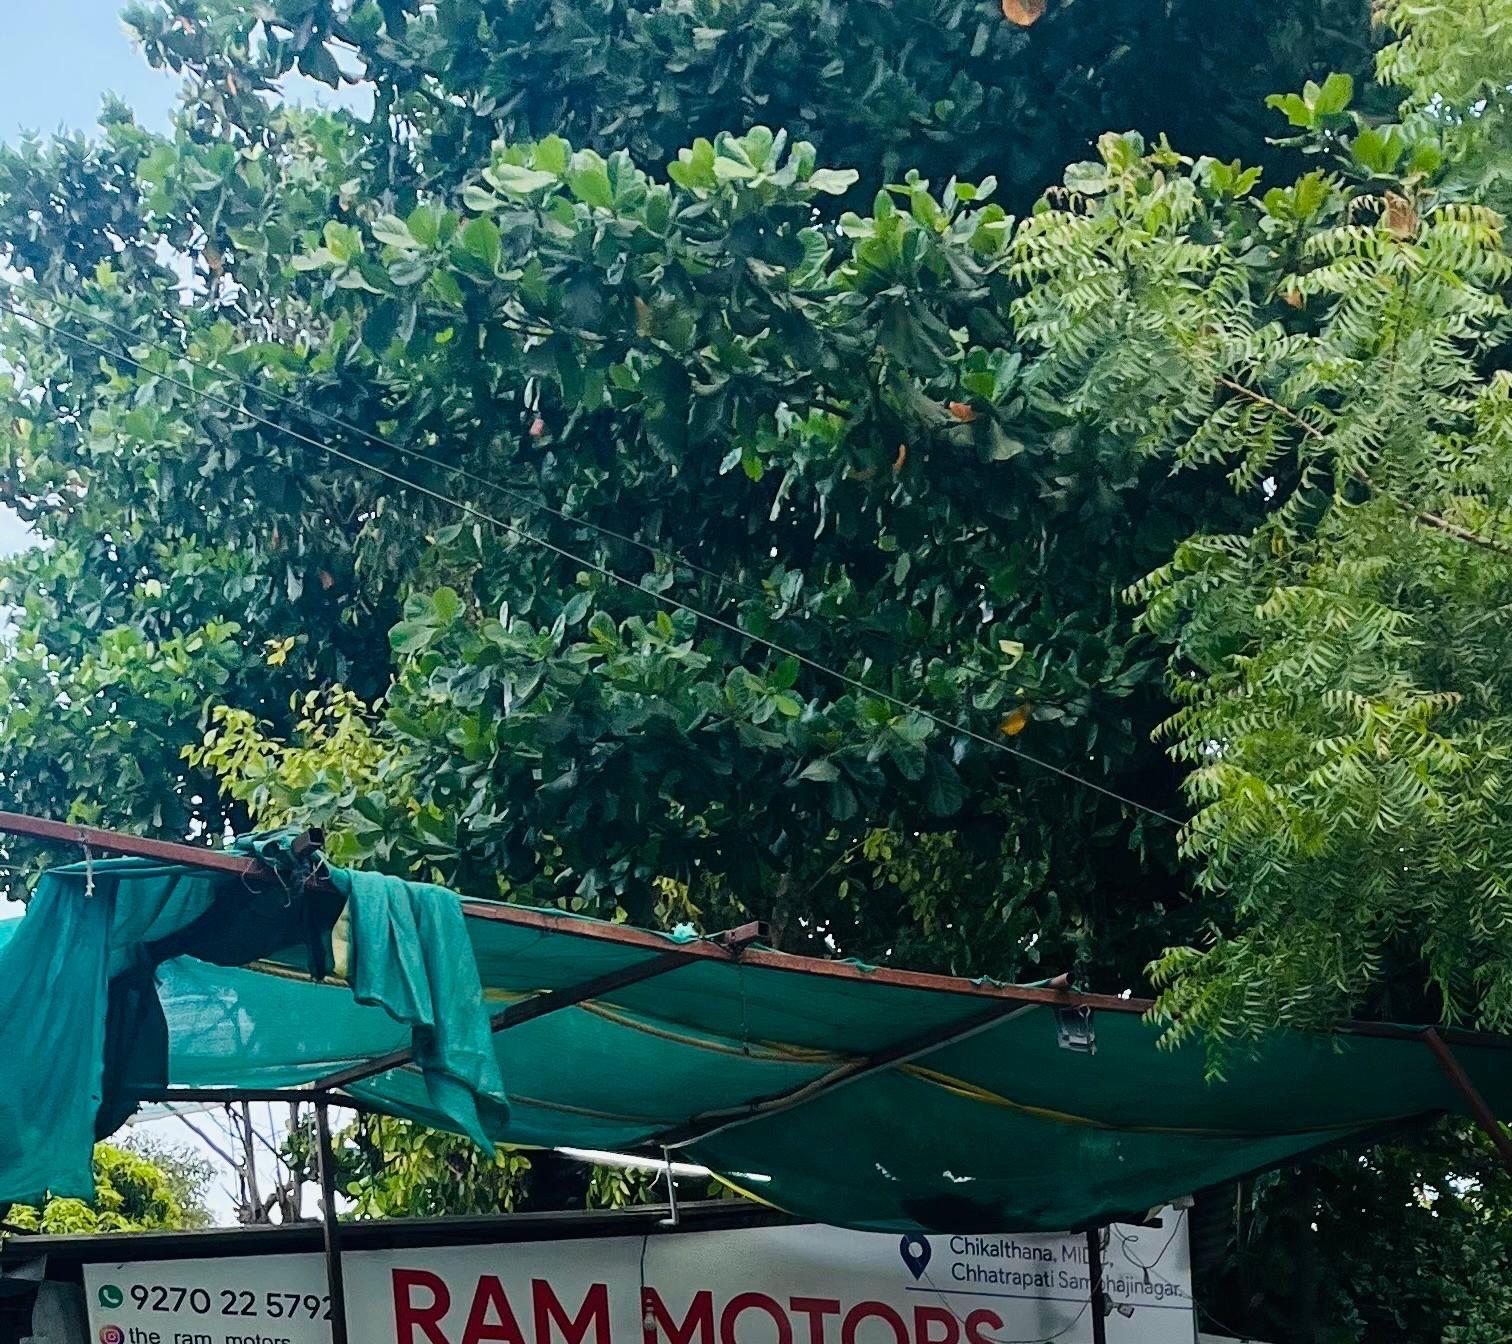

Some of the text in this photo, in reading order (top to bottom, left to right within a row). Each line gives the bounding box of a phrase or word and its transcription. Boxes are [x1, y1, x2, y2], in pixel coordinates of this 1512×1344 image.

[951, 1262, 1055, 1291] Chhatrapati
[130, 1284, 333, 1321] 9270 22 5792
